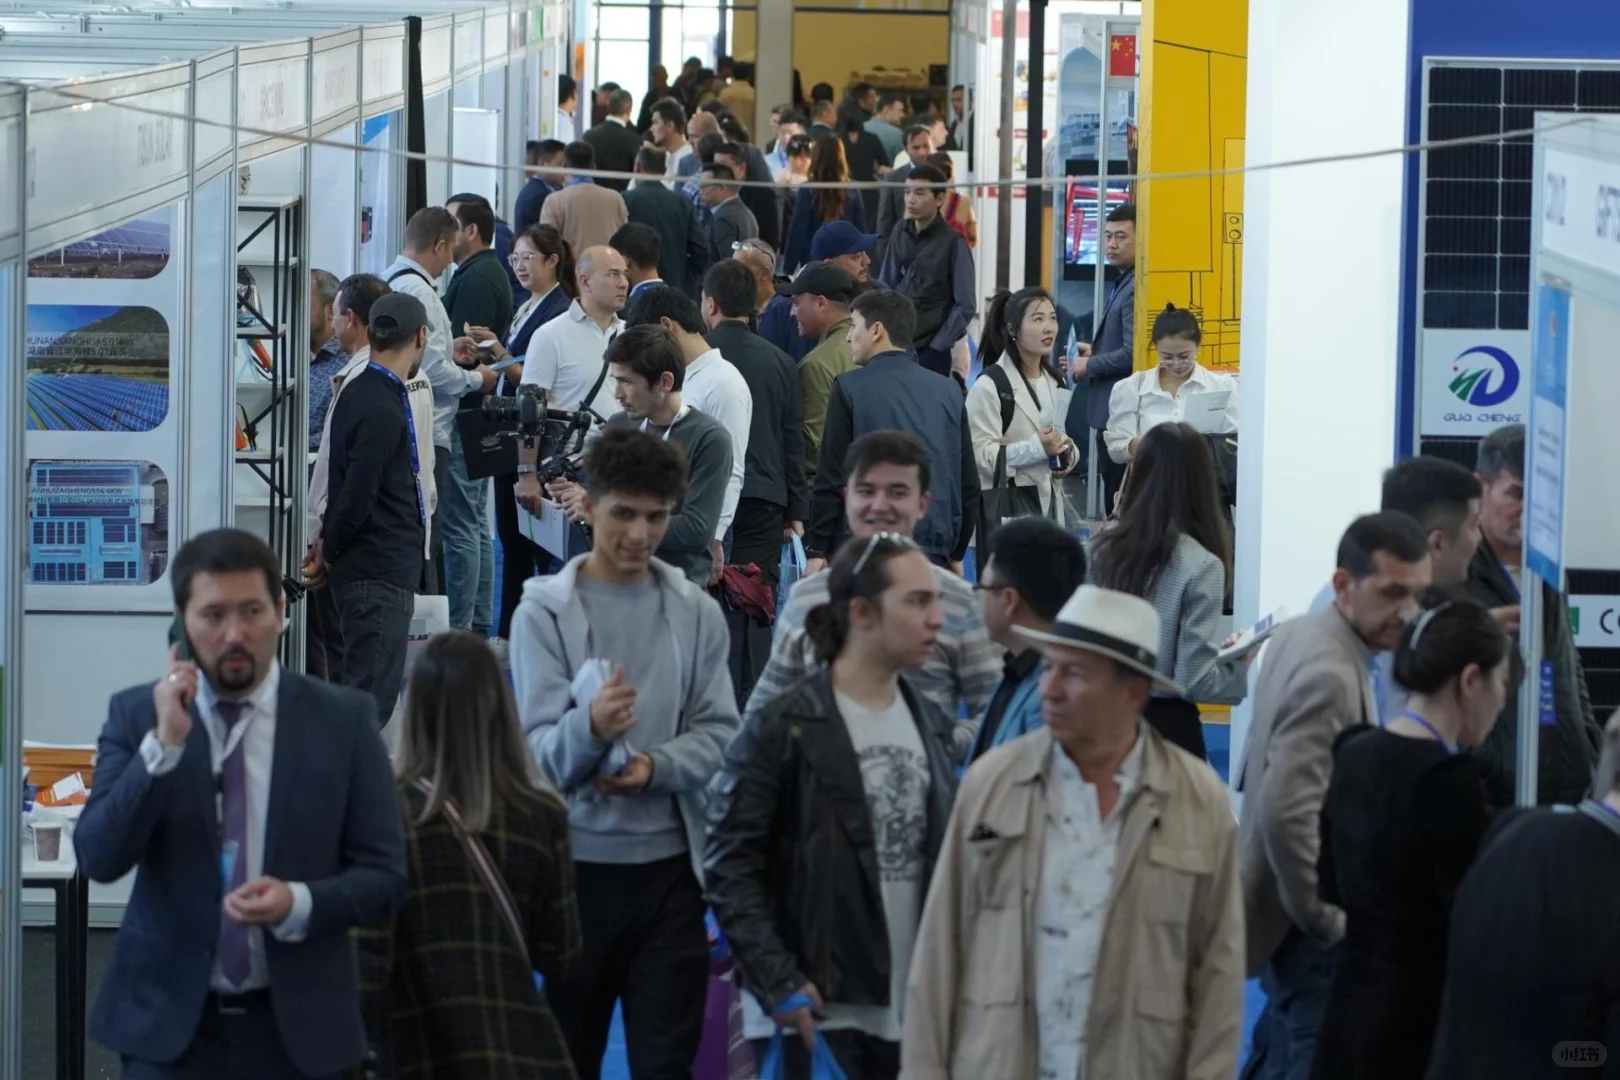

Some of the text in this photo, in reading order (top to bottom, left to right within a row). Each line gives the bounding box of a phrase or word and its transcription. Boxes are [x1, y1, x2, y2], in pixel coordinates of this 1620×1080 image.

[1443, 412, 1521, 422] GUO CHENG
[1599, 608, 1620, 635] C
